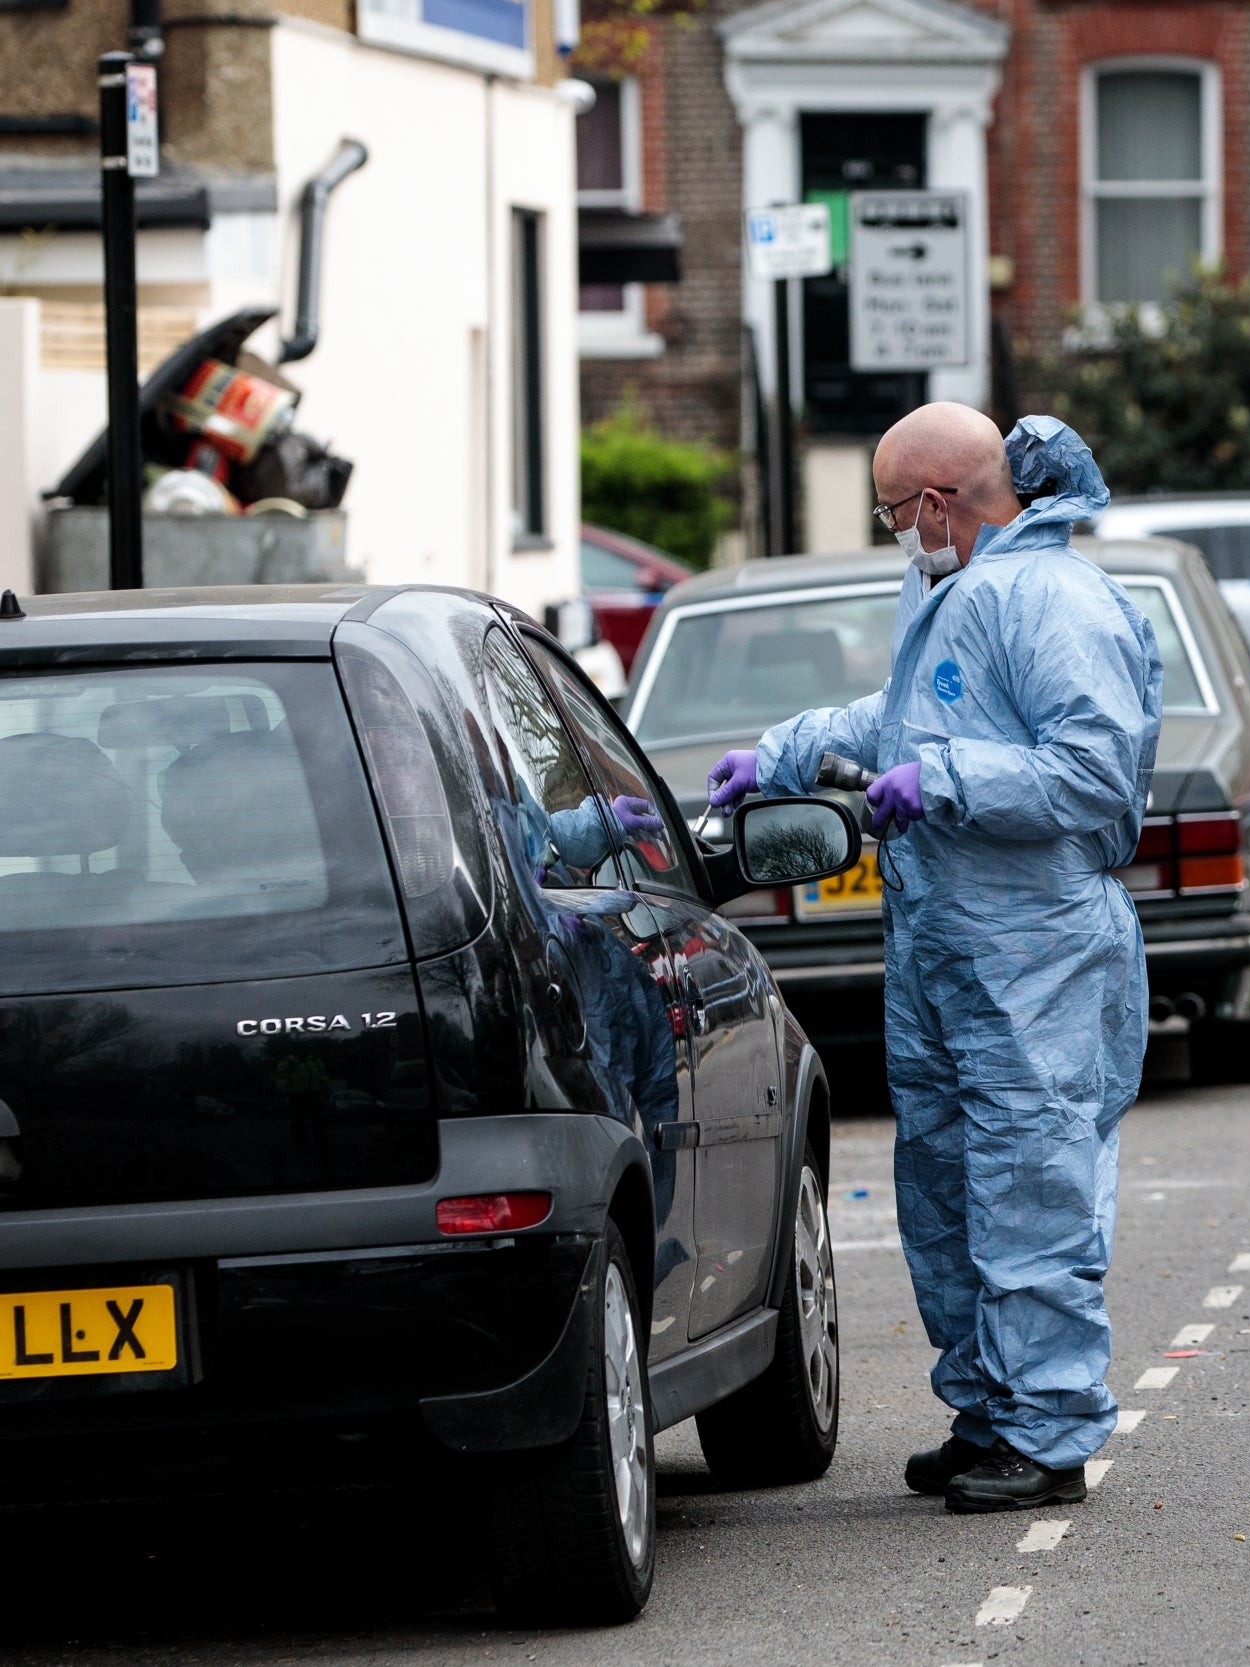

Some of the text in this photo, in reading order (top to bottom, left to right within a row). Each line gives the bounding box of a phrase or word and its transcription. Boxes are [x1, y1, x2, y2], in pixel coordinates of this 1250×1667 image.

[236, 1011, 398, 1036] CORSA 1.2
[13, 1298, 146, 1366] LLX
